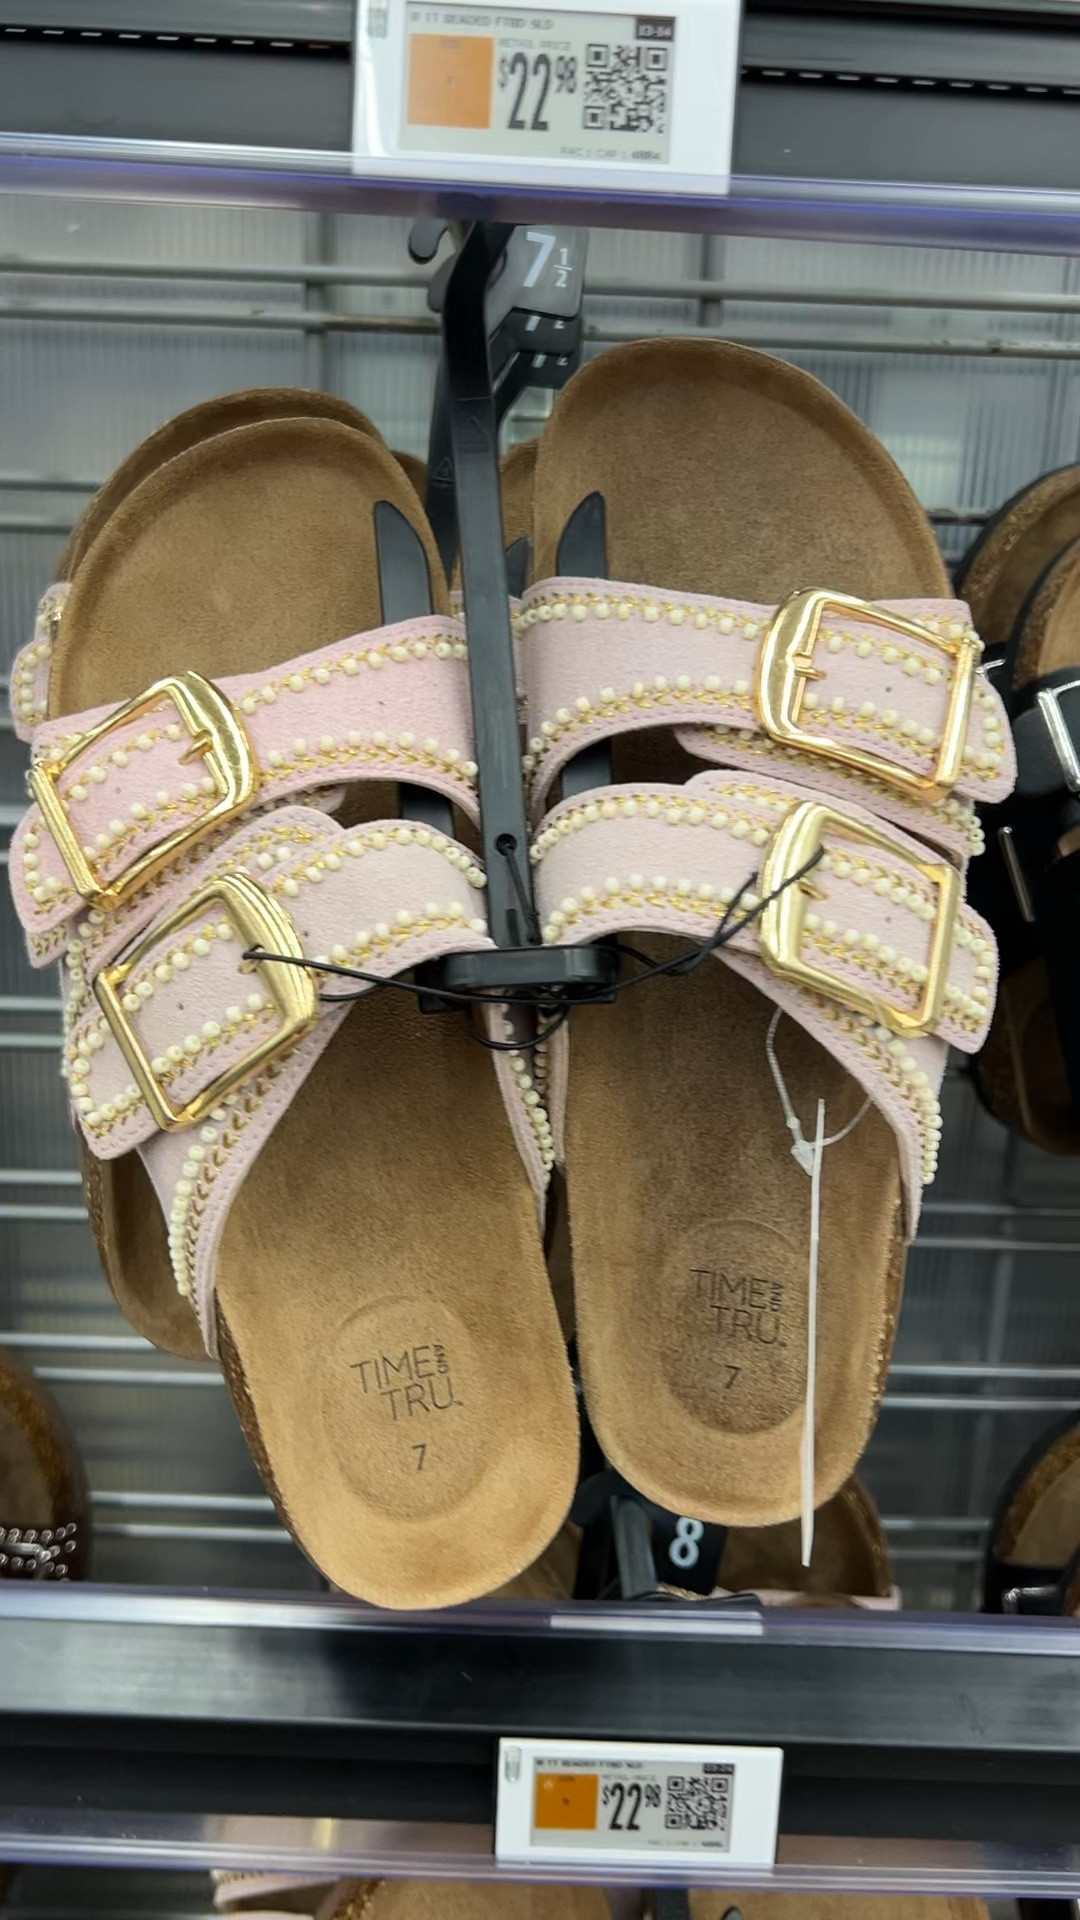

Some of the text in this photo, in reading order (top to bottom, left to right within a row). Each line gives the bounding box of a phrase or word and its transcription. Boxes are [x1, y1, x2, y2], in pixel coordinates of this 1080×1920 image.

[690, 1268, 768, 1309] TIME
[350, 1344, 435, 1393] TIME
[724, 1364, 742, 1389] 7
[411, 1443, 427, 1470] 7
[668, 1516, 704, 1570] 8
